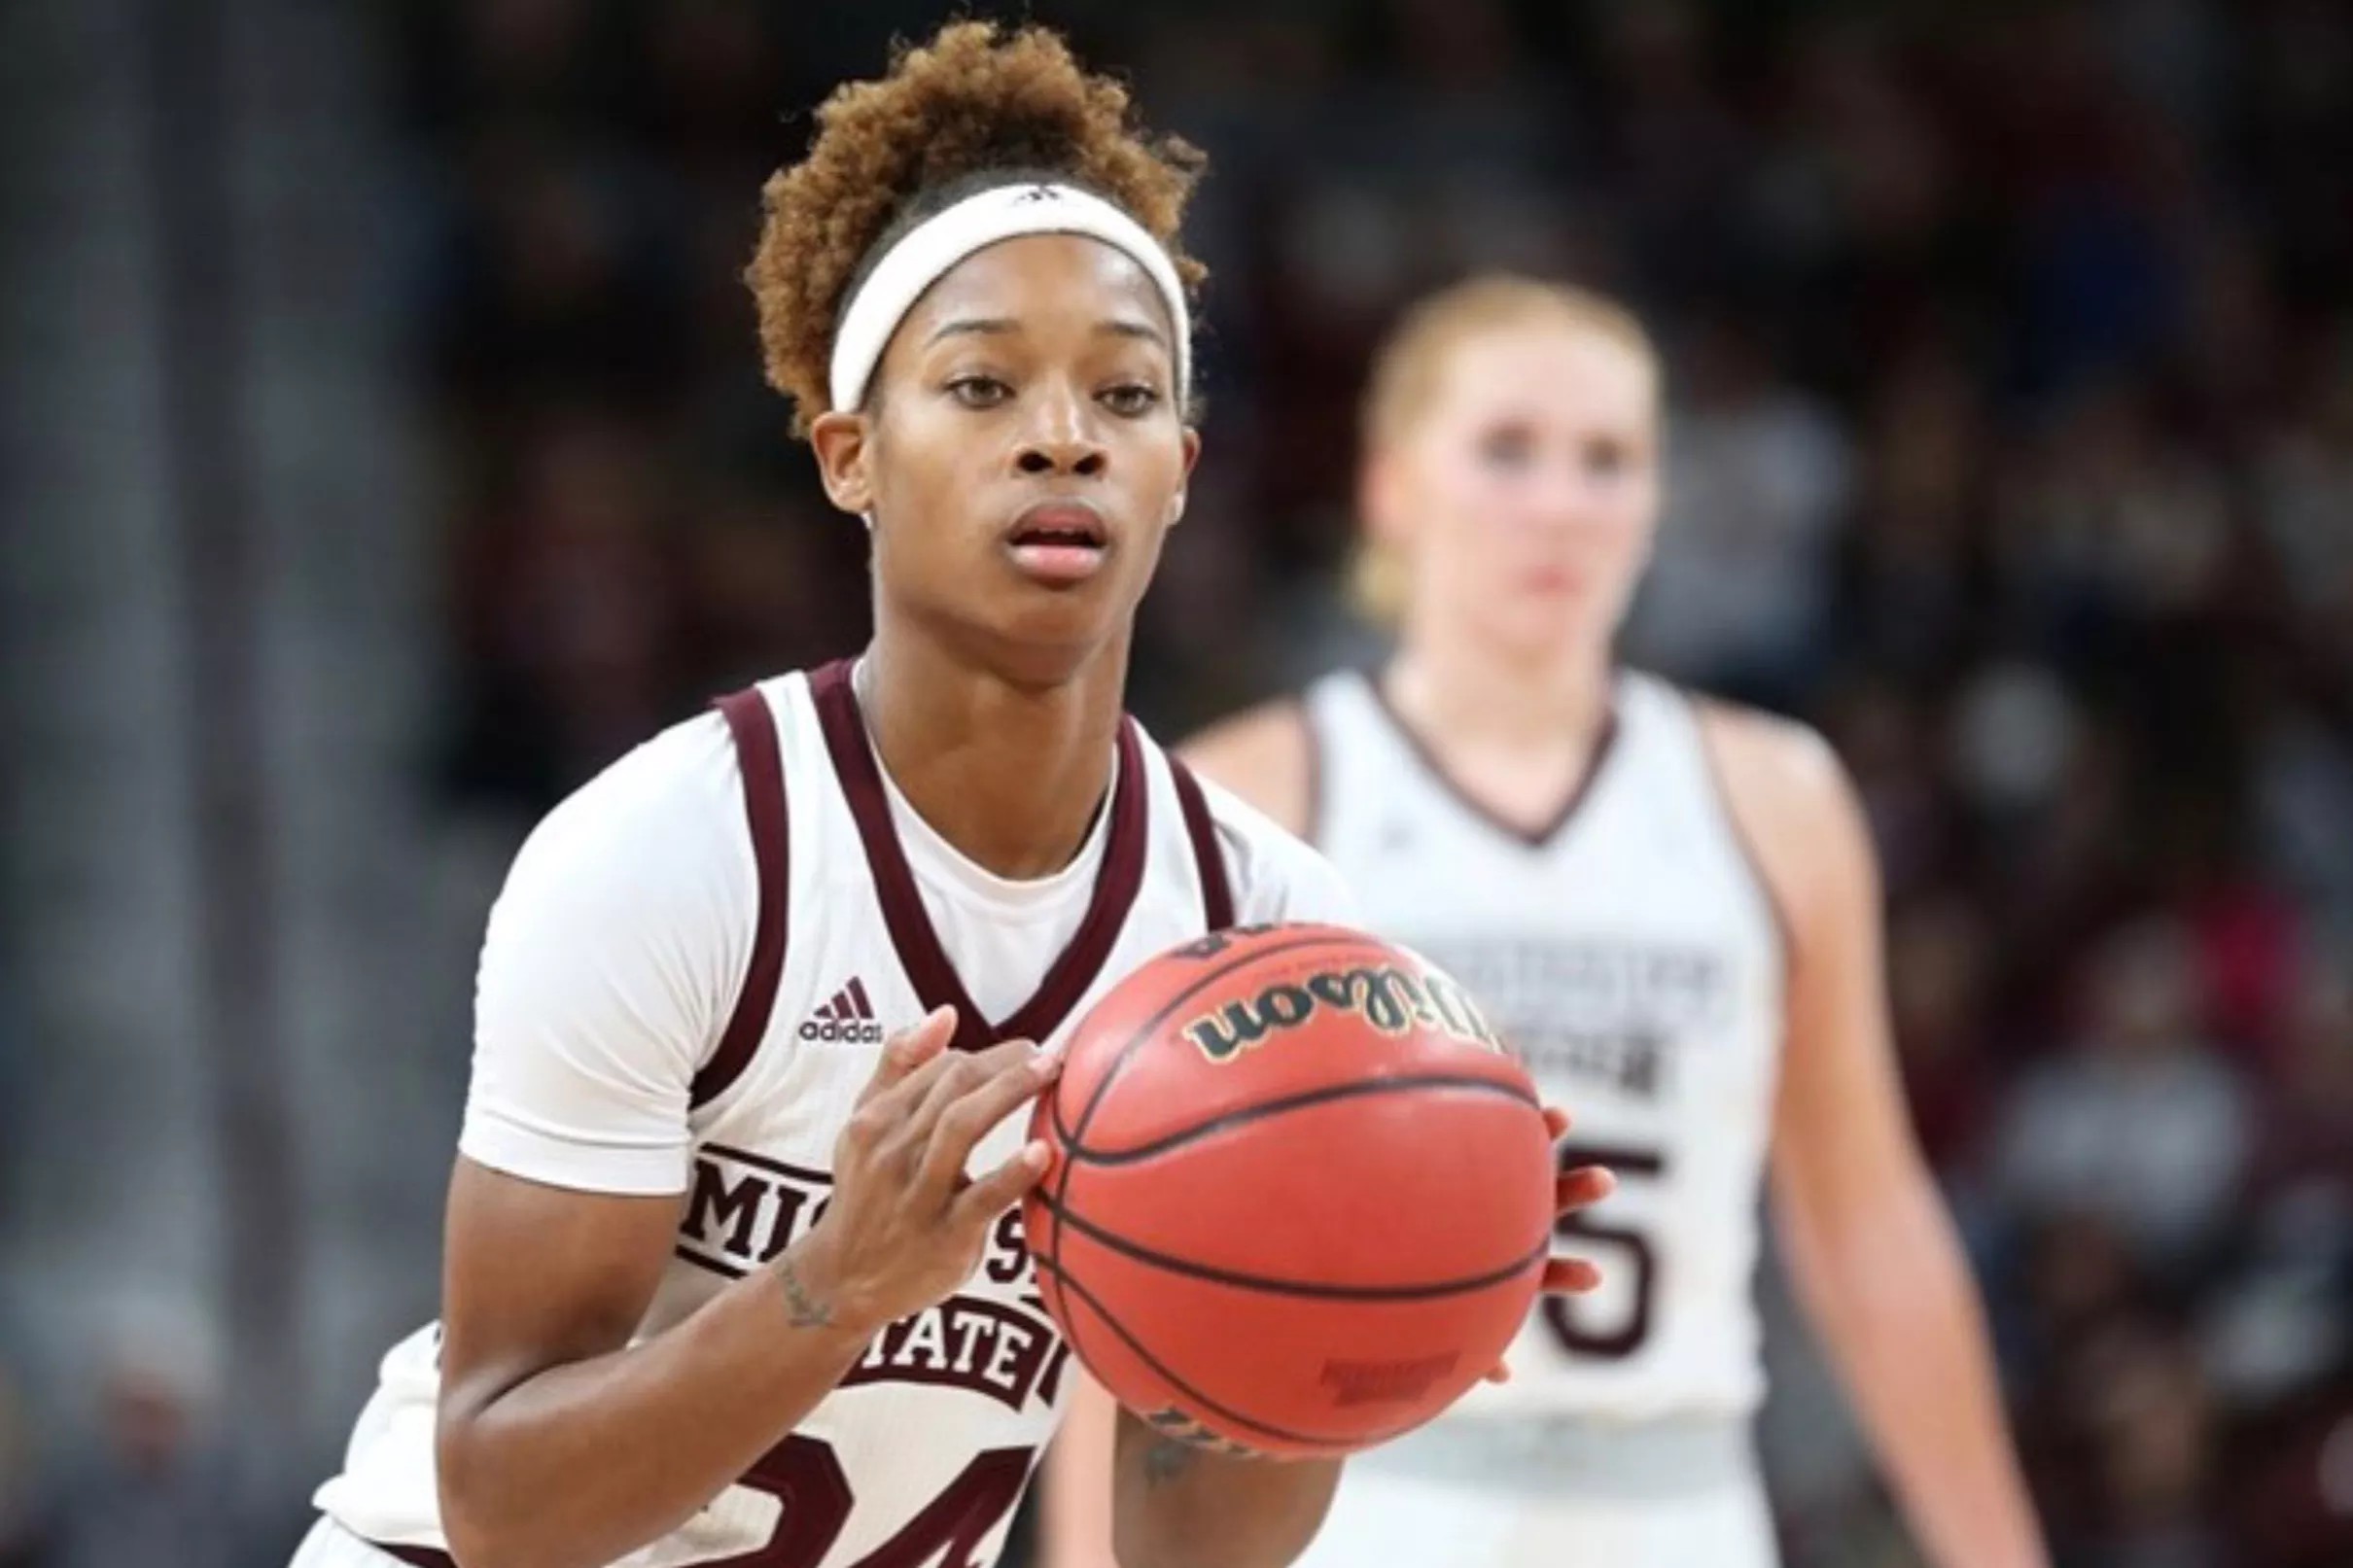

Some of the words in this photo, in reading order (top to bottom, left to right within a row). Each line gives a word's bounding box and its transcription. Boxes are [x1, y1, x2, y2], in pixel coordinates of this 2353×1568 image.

[799, 1017, 883, 1044] adidas
[1182, 963, 1509, 1063] Wilson
[861, 1307, 1034, 1390] TATE
